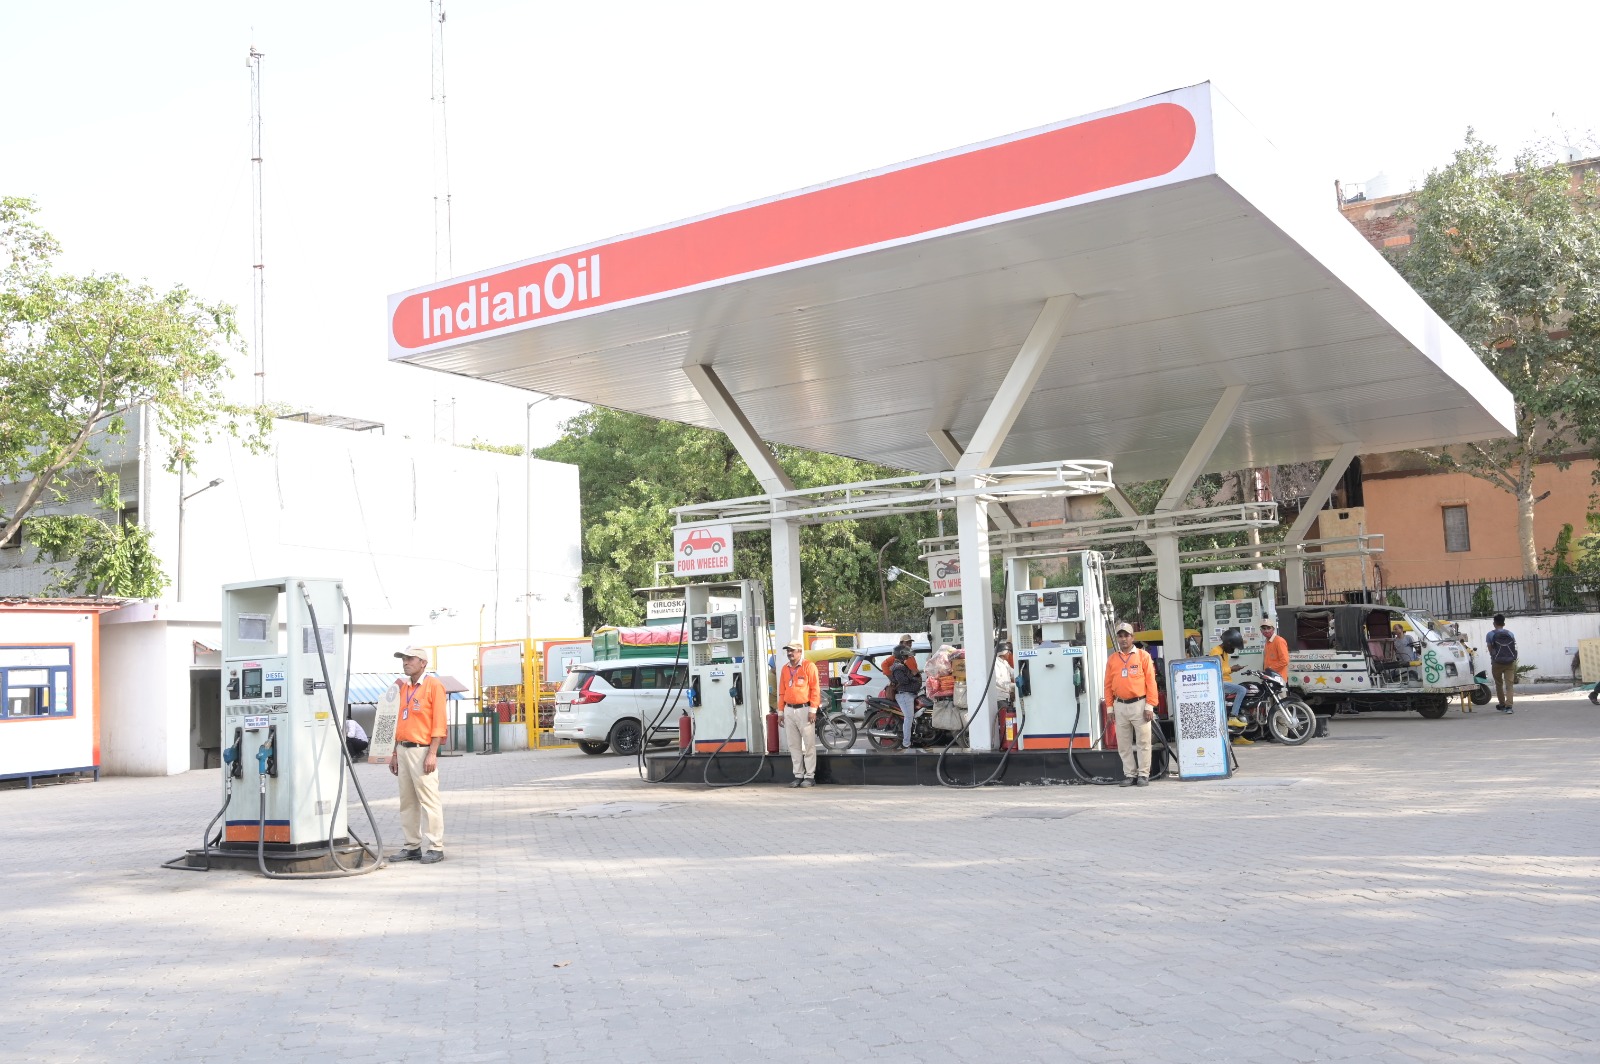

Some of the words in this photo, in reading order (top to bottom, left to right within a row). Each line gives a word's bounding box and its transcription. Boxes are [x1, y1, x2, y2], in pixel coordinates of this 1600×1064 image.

[422, 253, 601, 340] IndianOil
[677, 559, 695, 572] FOUR
[696, 556, 729, 570] WHEELER
[932, 579, 947, 590] TWO
